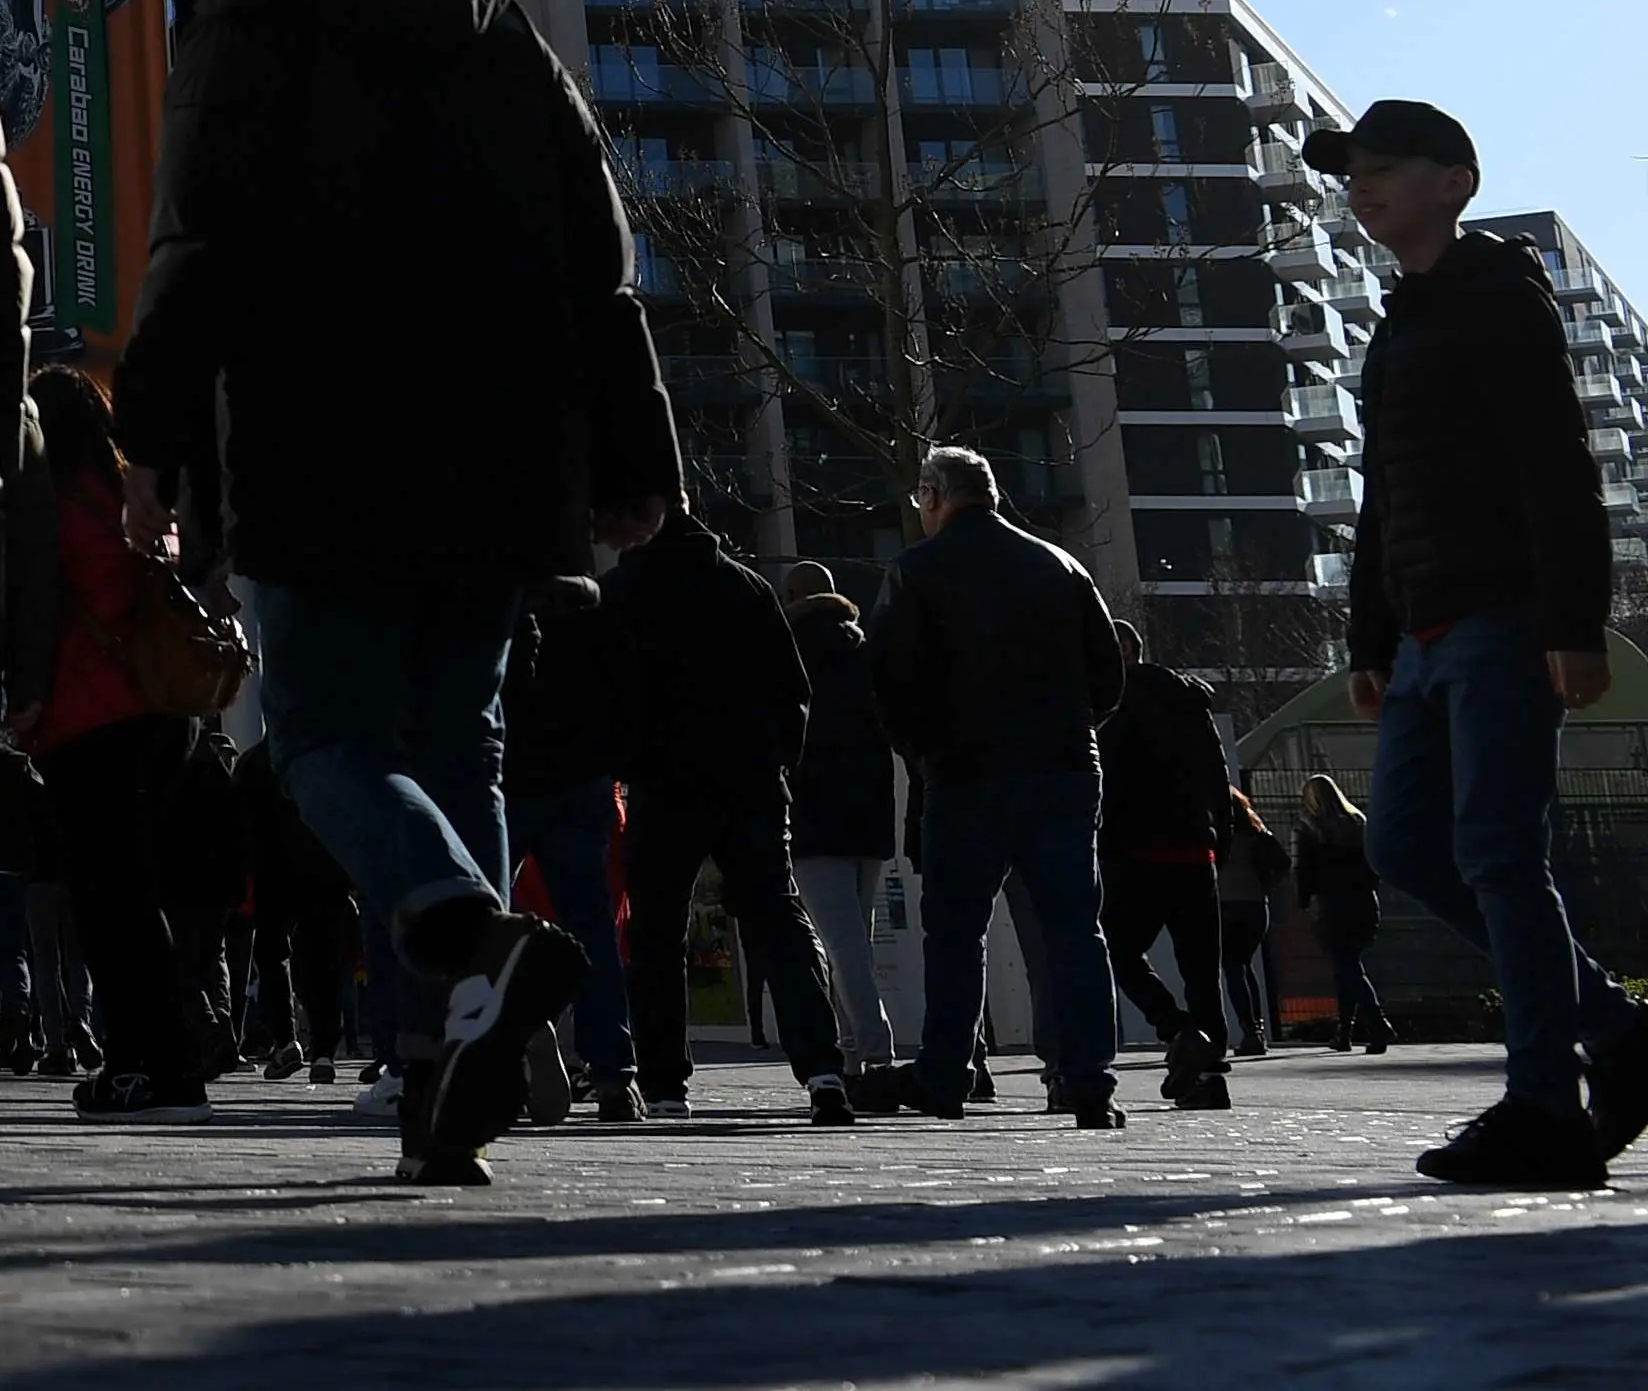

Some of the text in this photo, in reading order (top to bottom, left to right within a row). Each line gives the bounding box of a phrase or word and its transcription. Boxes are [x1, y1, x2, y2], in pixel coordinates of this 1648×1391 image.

[68, 25, 97, 308] Carabao ENERGY DRINK
